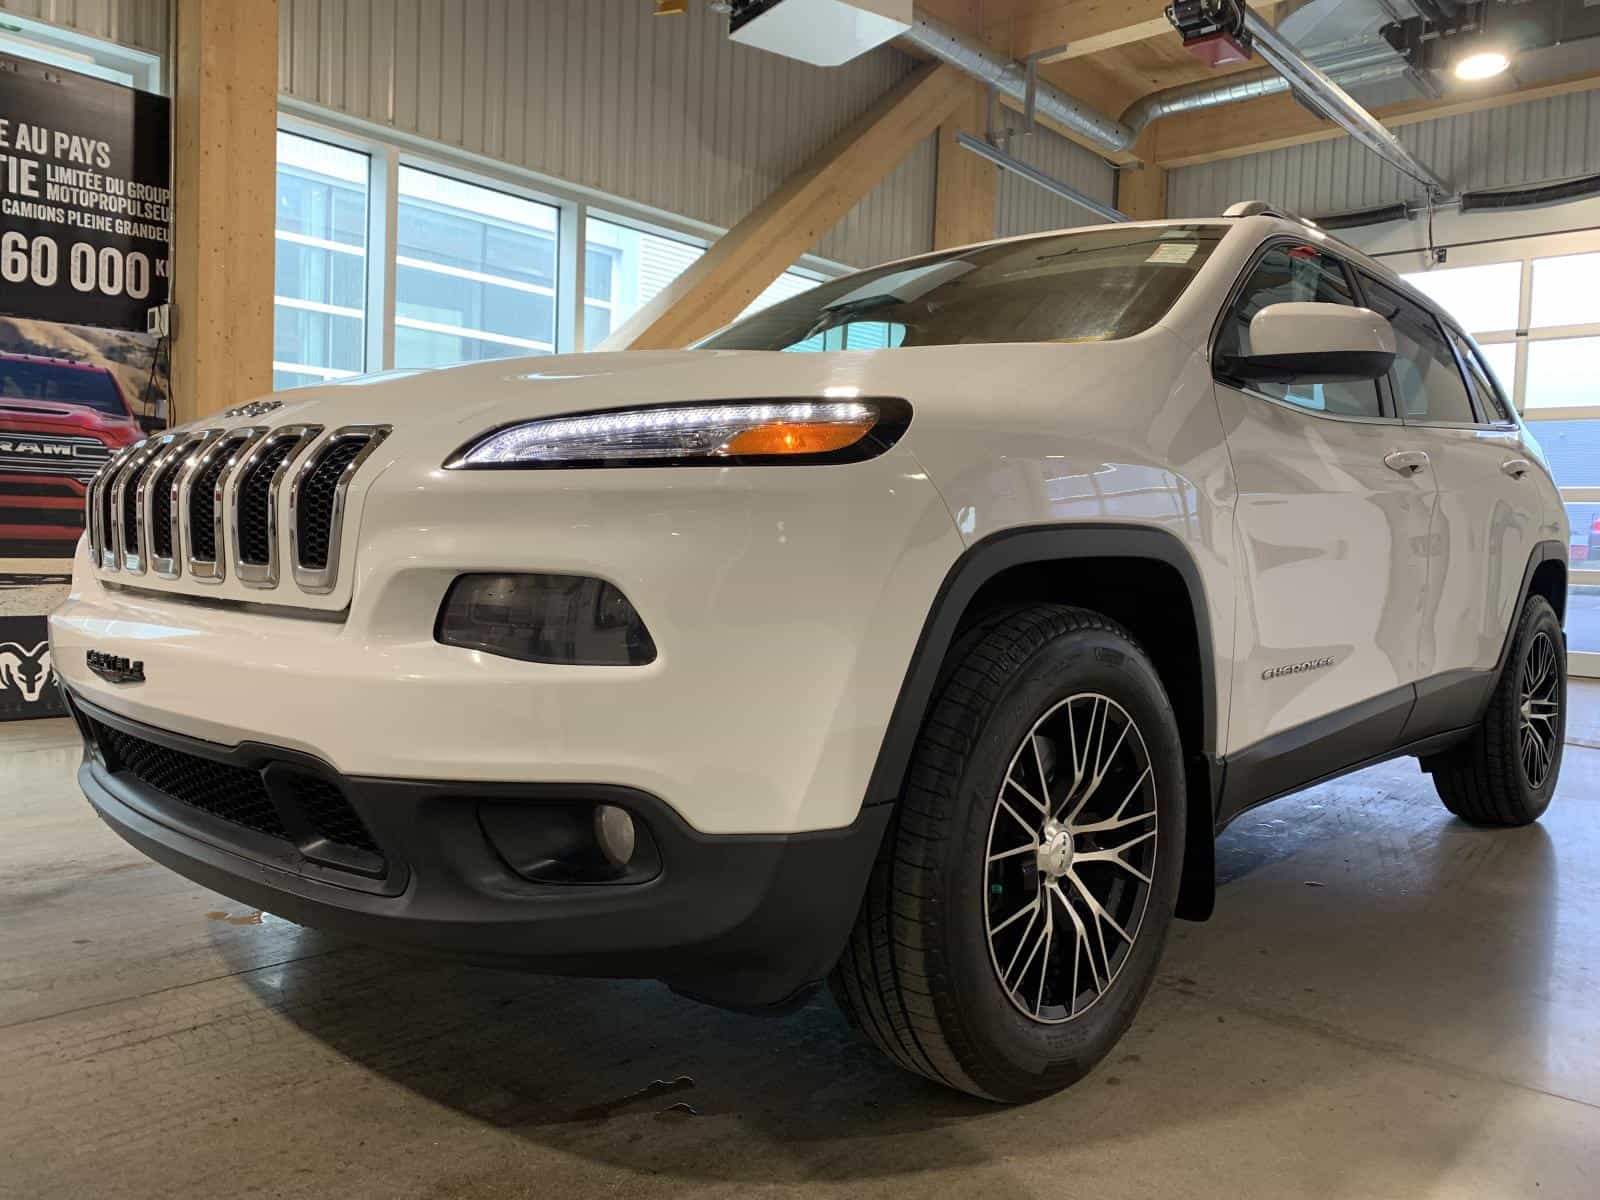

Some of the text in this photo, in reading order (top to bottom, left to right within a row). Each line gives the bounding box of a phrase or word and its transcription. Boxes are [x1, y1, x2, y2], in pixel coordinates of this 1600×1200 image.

[15, 123, 47, 155] AU
[54, 131, 110, 168] PAYS
[46, 164, 103, 191] LIMITÉE
[106, 177, 124, 196] DU
[2, 198, 65, 223] CAMIONS
[68, 210, 113, 233] PLEINE
[1, 231, 58, 287] 60
[70, 242, 149, 299] 000
[0, 441, 71, 456] RAM
[1262, 656, 1336, 680] CHEROKEE
